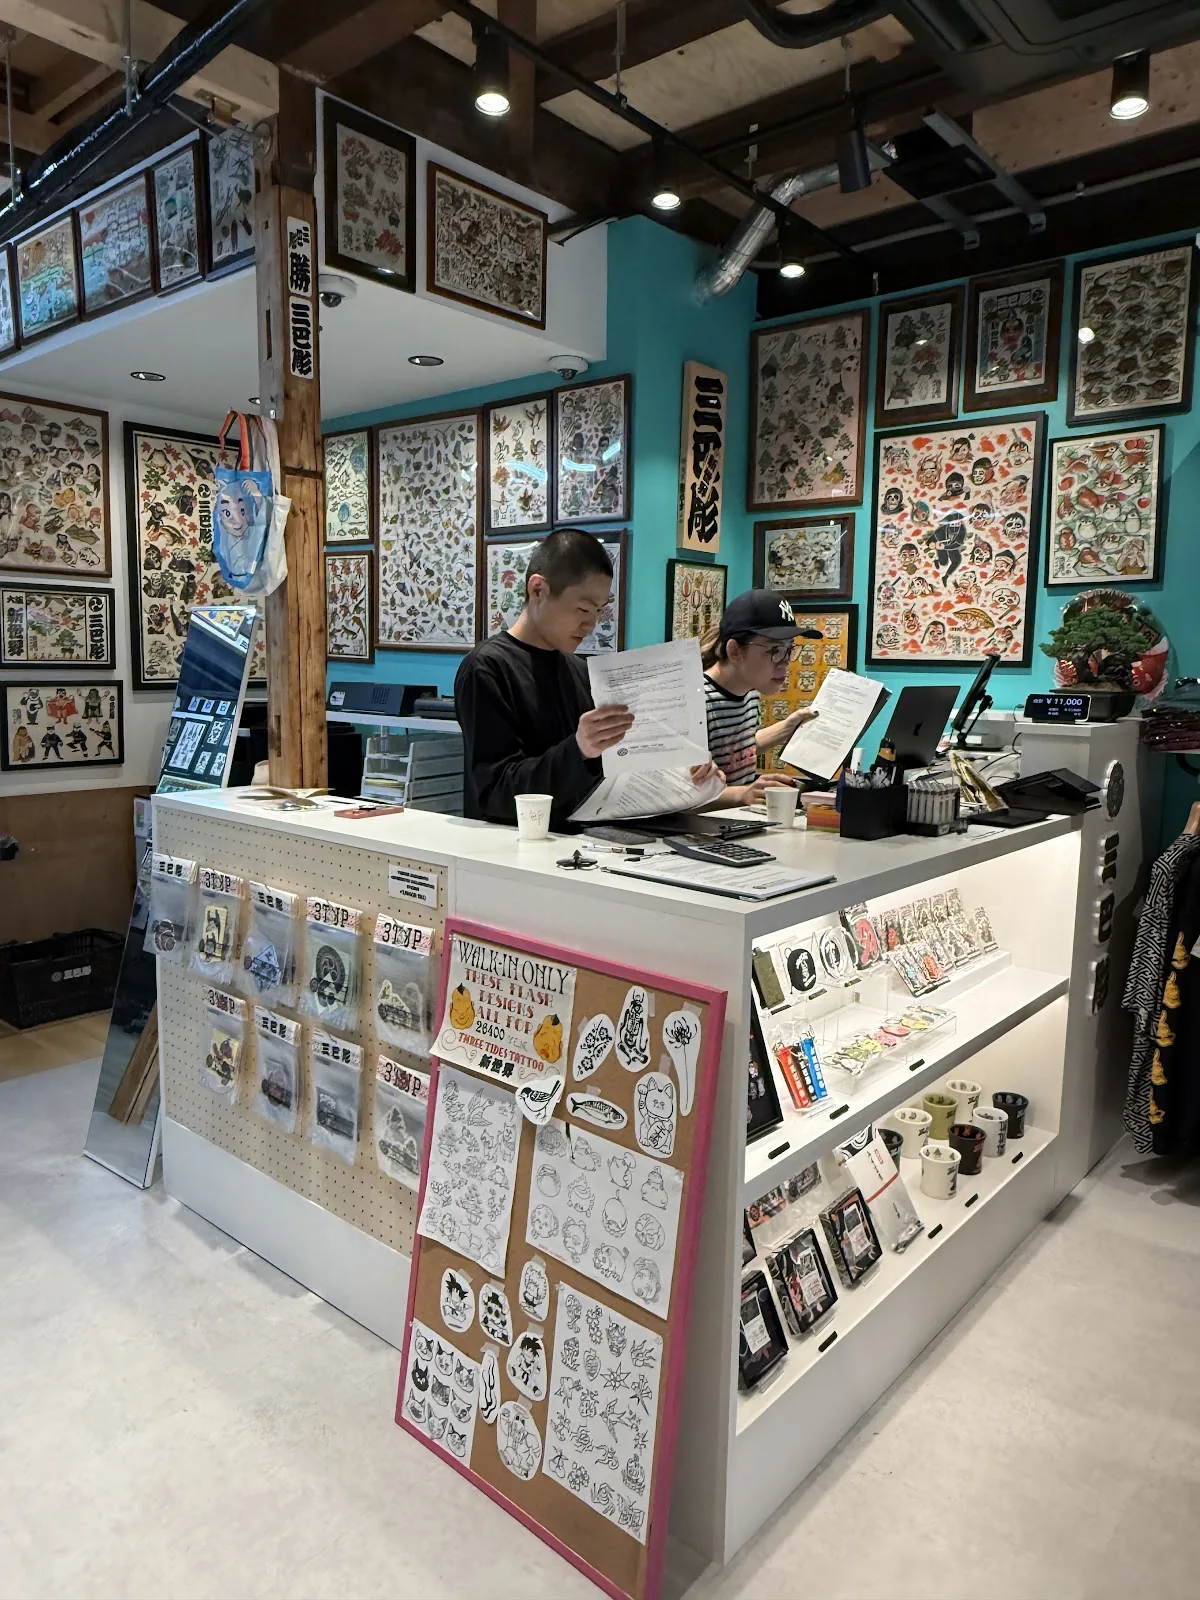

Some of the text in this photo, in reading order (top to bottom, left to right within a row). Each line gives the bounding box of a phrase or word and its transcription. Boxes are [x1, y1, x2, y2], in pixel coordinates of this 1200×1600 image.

[291, 302, 313, 376] 三巴彫
[198, 500, 213, 545] 三巴彫
[778, 600, 795, 622] NY
[88, 614, 105, 660] 三巴彫
[1054, 698, 1083, 706] 11,000
[458, 940, 569, 994] WALK-IN ONLY
[464, 968, 555, 1009] THESE FLASH
[478, 989, 534, 1019] DESIGNS
[475, 1005, 534, 1035] ALL FOR
[458, 1032, 545, 1072] THREE TIDES TATTOO
